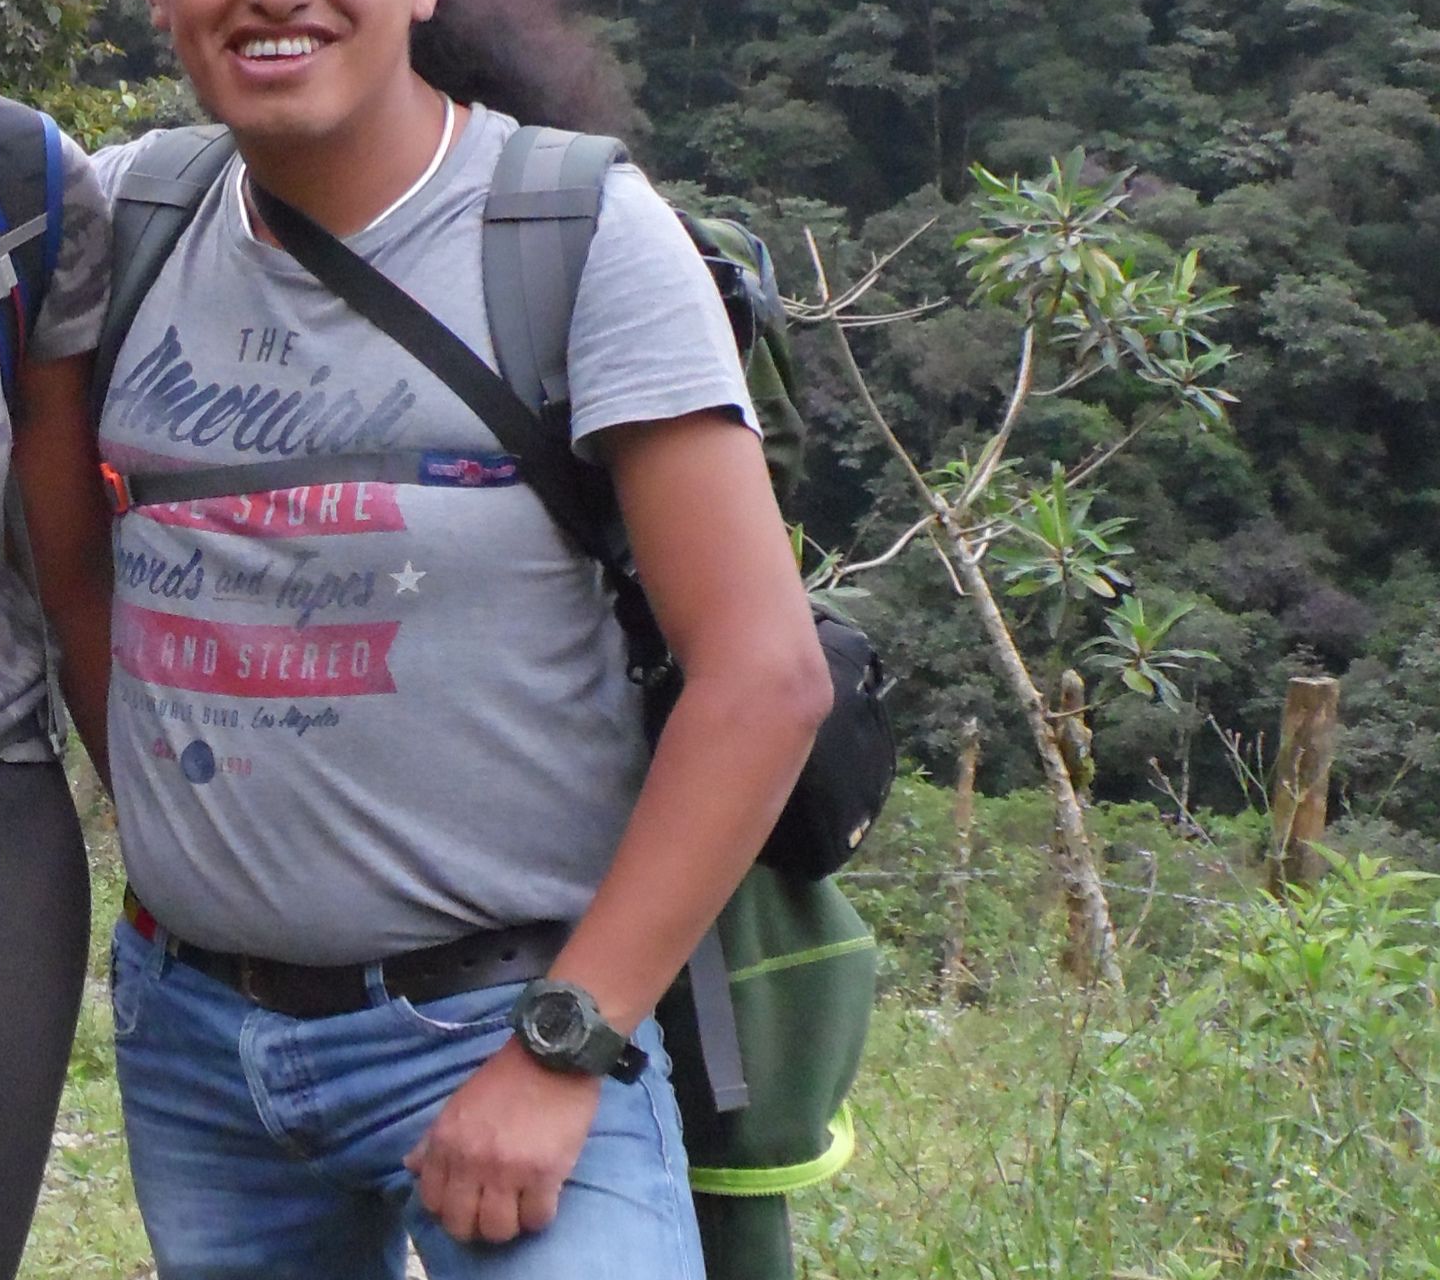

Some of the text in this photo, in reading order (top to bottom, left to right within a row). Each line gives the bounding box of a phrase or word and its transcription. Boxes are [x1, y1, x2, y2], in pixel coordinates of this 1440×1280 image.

[239, 327, 300, 366] THE
[232, 481, 374, 526] STORE
[213, 560, 274, 597] and
[160, 631, 218, 674] AND
[237, 640, 371, 680] STEREO
